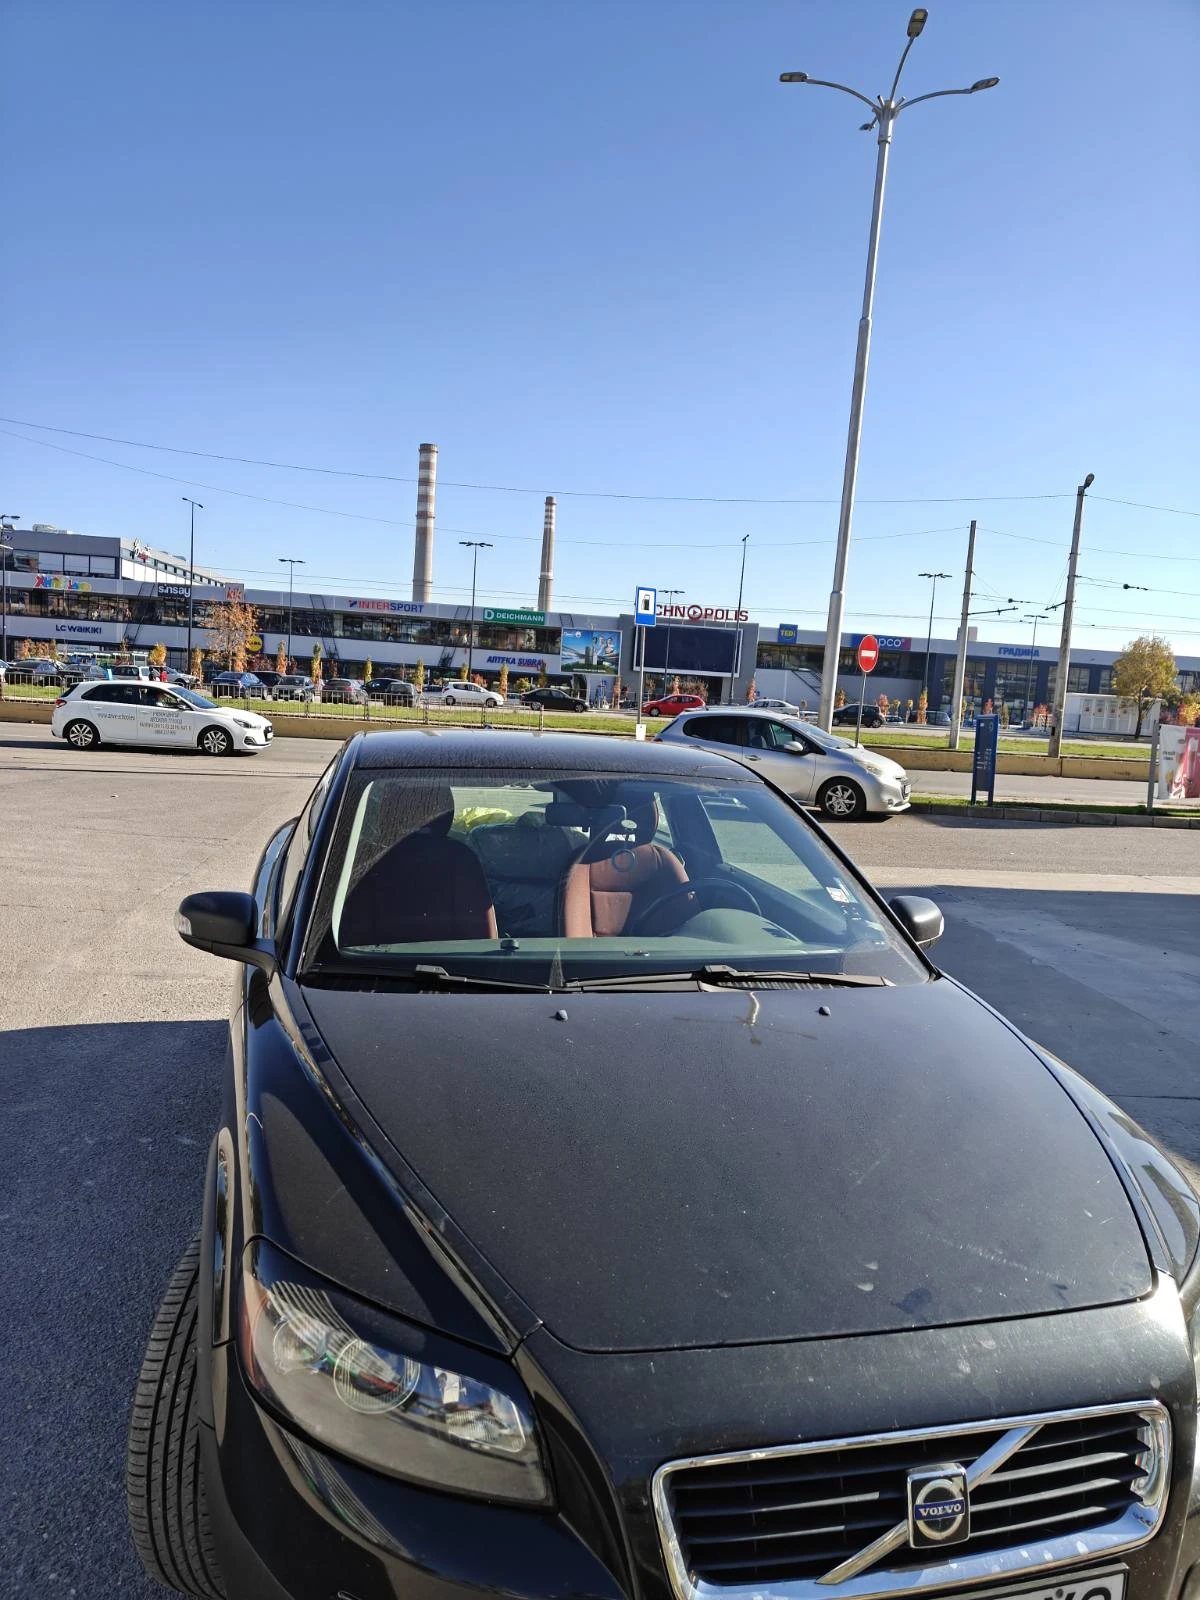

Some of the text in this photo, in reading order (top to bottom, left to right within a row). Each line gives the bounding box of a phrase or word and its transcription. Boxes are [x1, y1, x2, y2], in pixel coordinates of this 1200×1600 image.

[158, 584, 191, 598] sinsay
[358, 600, 424, 613] INTERSPORT
[496, 612, 544, 622] DEICHMANN
[656, 604, 749, 622] CHNOPOLIS
[55, 624, 66, 632] LC
[878, 638, 902, 649] pco
[998, 646, 1040, 657] ГРАДИНА
[486, 656, 516, 665] АПТЕКА
[918, 1503, 962, 1517] VOLVO
